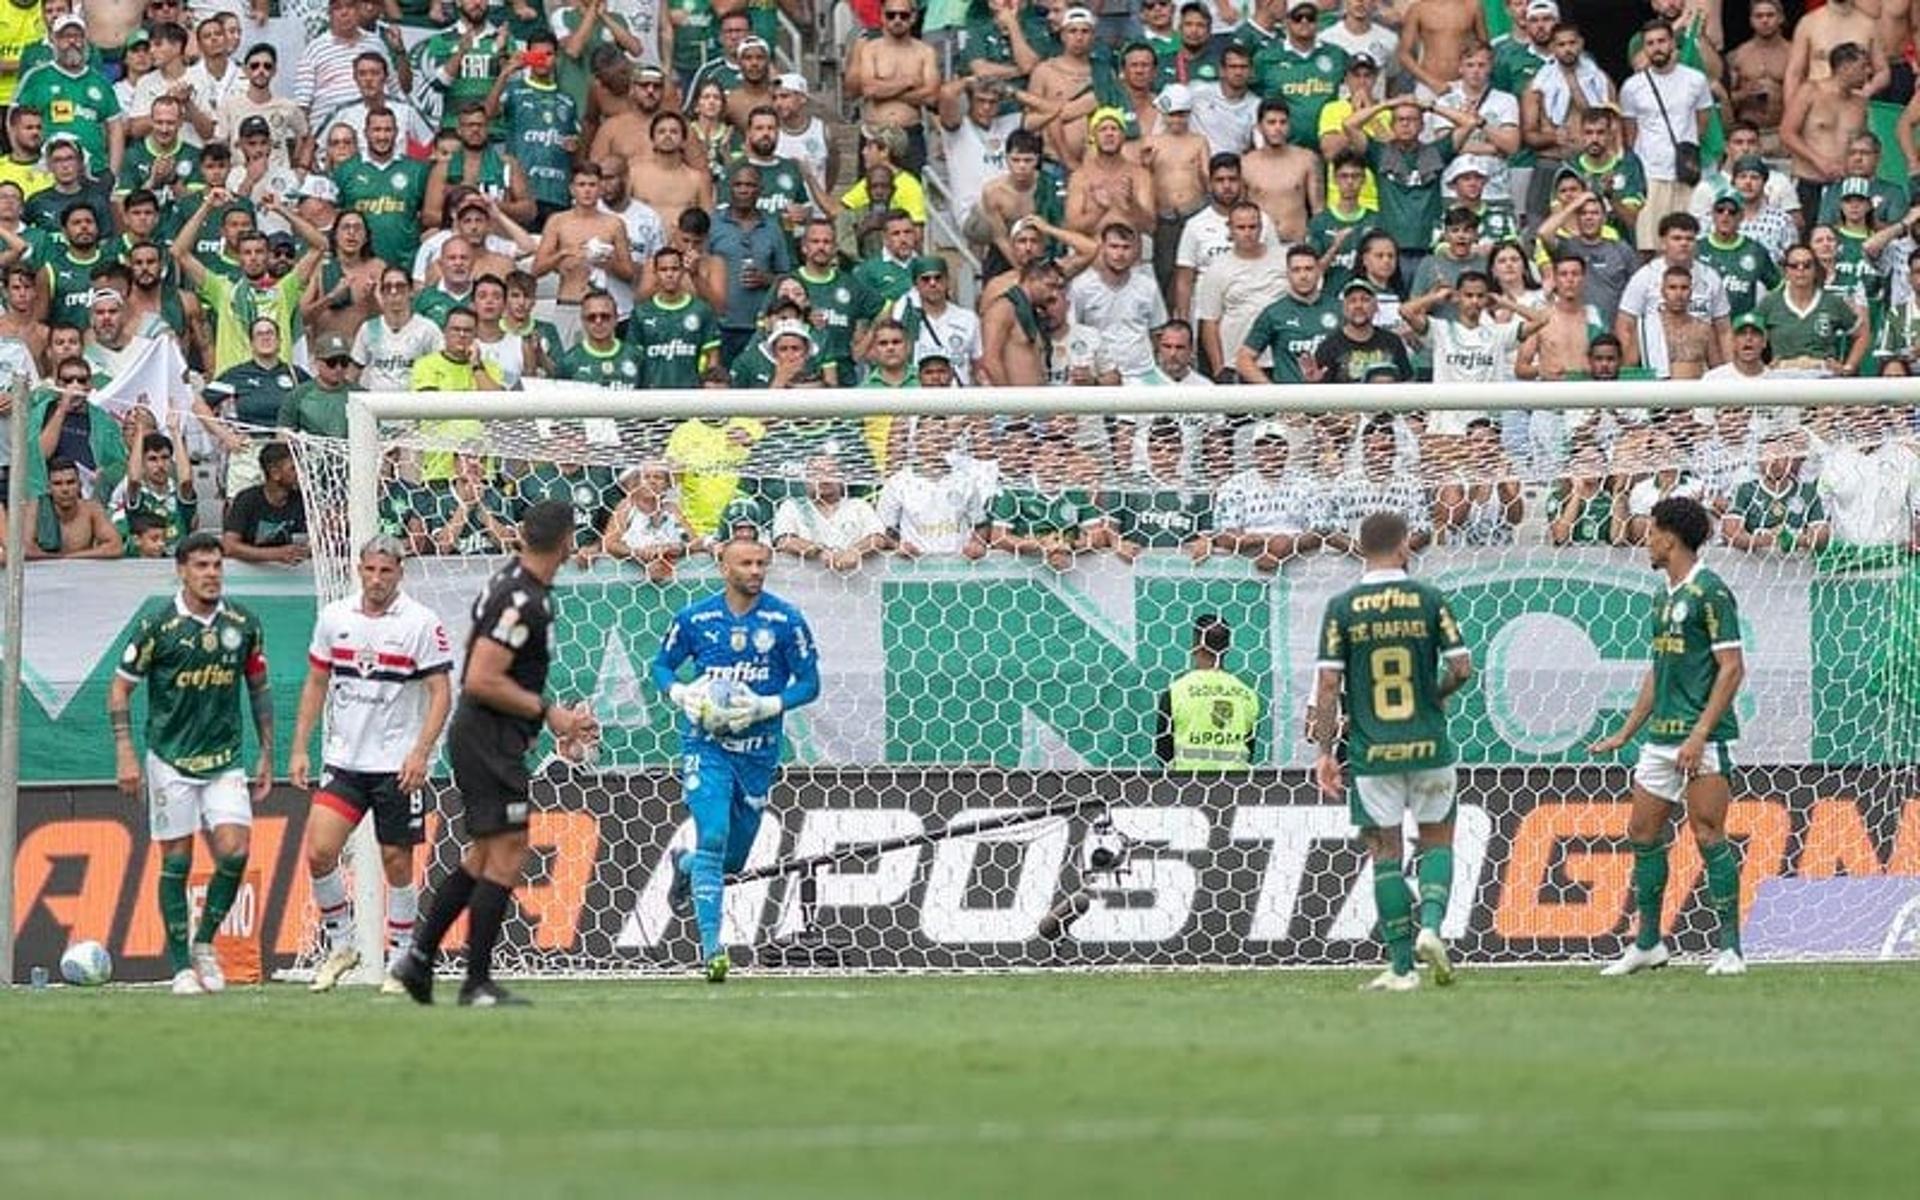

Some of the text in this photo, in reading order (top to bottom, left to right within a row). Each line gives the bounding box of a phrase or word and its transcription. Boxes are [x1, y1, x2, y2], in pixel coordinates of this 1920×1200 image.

[1208, 245, 1232, 257] cre
[65, 288, 97, 308] cref
[648, 338, 695, 360] crefisa
[1446, 354, 1493, 369] crefisa
[1351, 588, 1420, 613] crefisa
[1371, 647, 1415, 721] 8
[616, 804, 1492, 948] APOSTA
